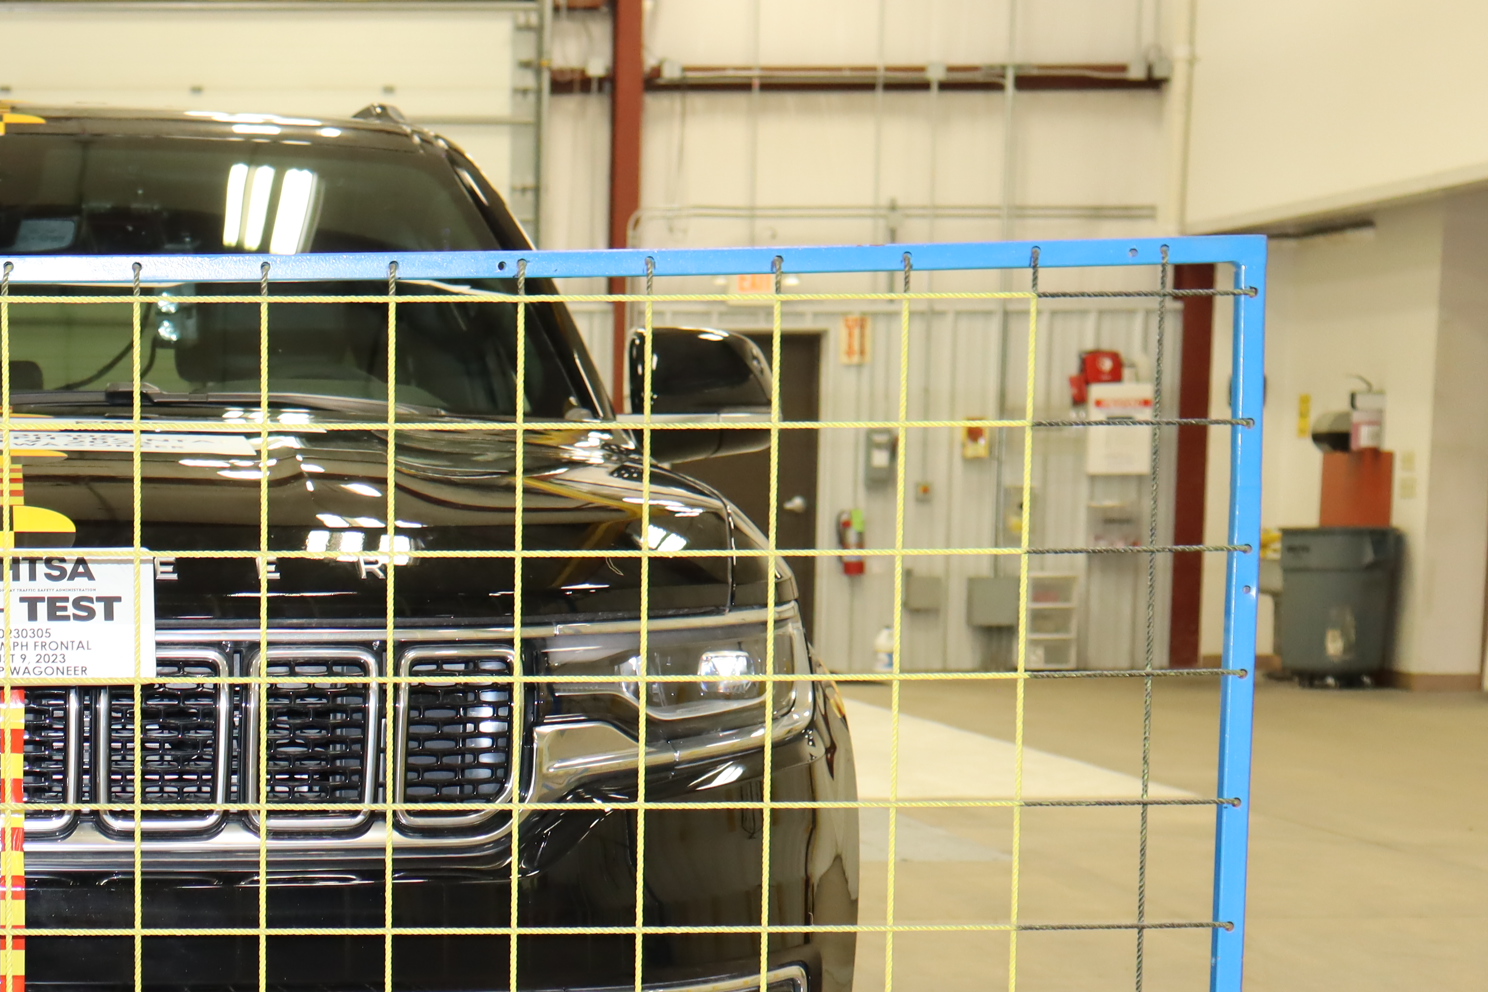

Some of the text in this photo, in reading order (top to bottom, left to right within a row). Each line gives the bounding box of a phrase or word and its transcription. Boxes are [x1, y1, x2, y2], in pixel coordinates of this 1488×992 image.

[18, 595, 123, 622] TEST
[0, 641, 29, 651] MPH
[33, 640, 92, 651] FRONTAL
[20, 653, 31, 665] 9,
[35, 653, 67, 664] 2023
[9, 665, 88, 676] WAGONEER
